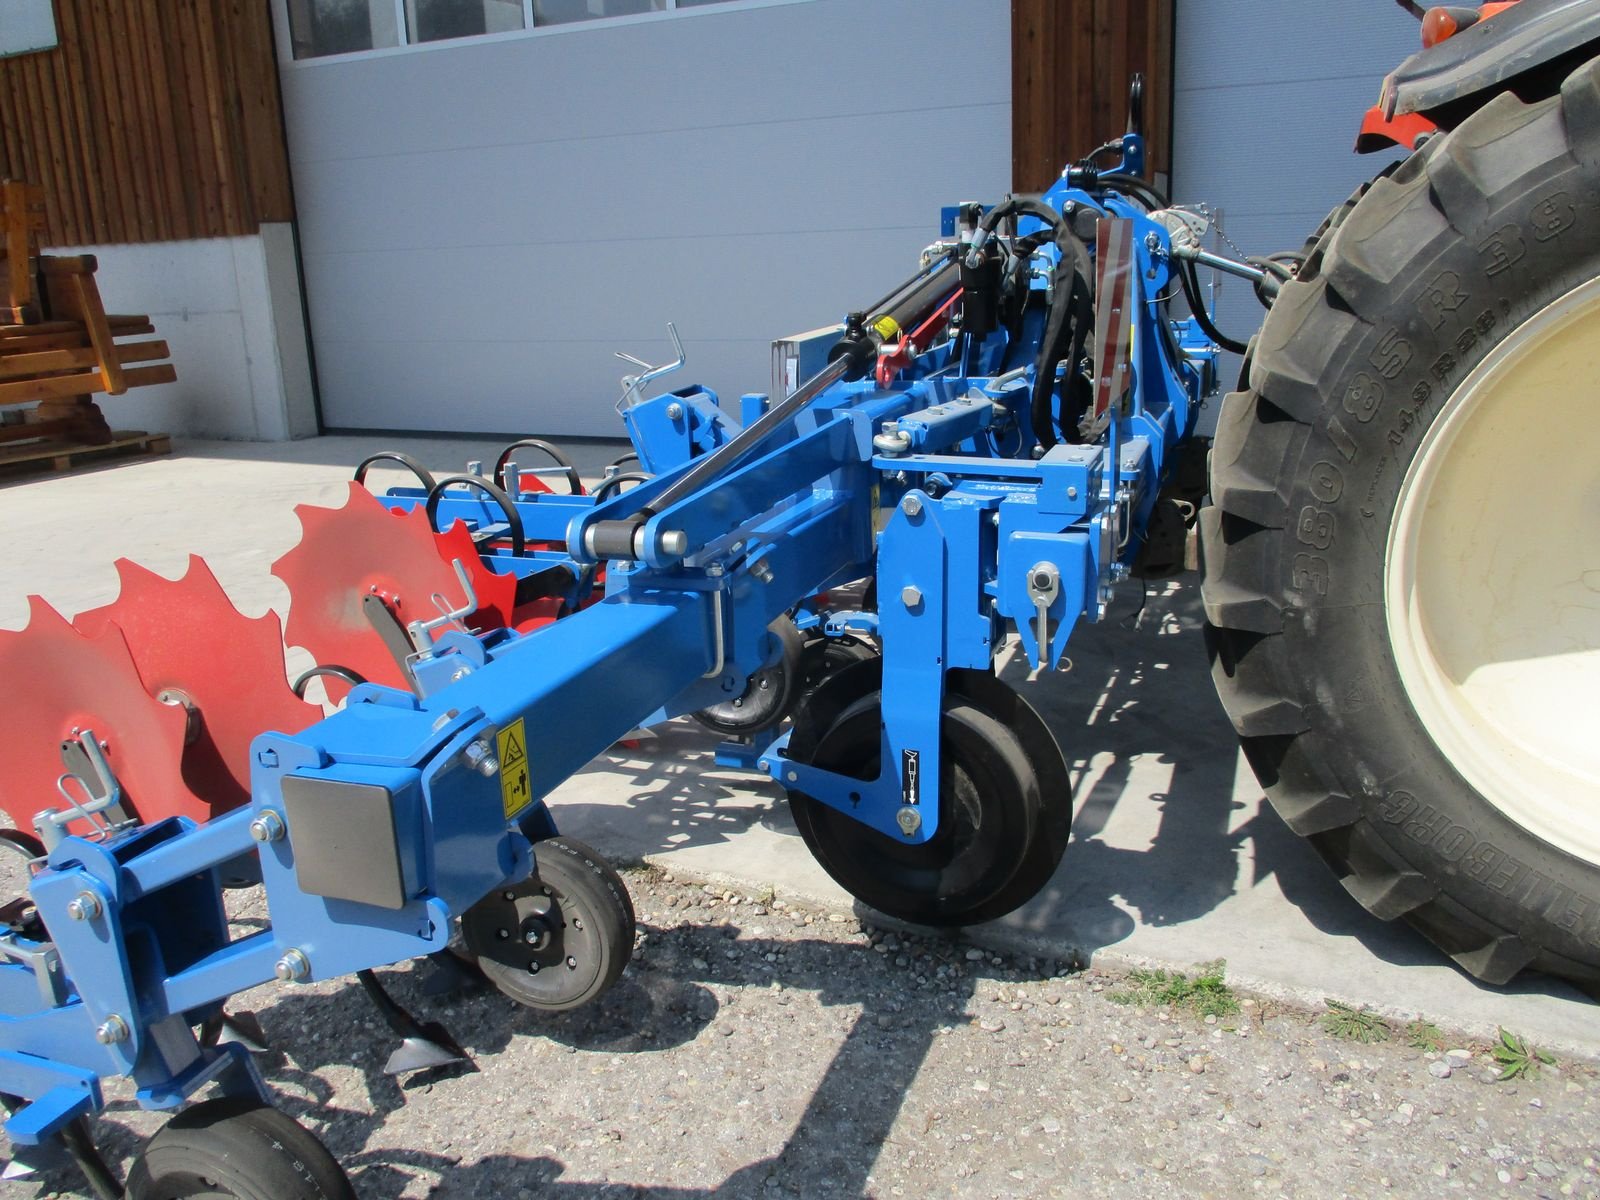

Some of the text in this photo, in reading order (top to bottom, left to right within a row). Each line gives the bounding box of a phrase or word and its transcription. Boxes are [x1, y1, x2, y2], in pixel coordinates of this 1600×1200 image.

[1292, 191, 1576, 596] 380/85 R 38
